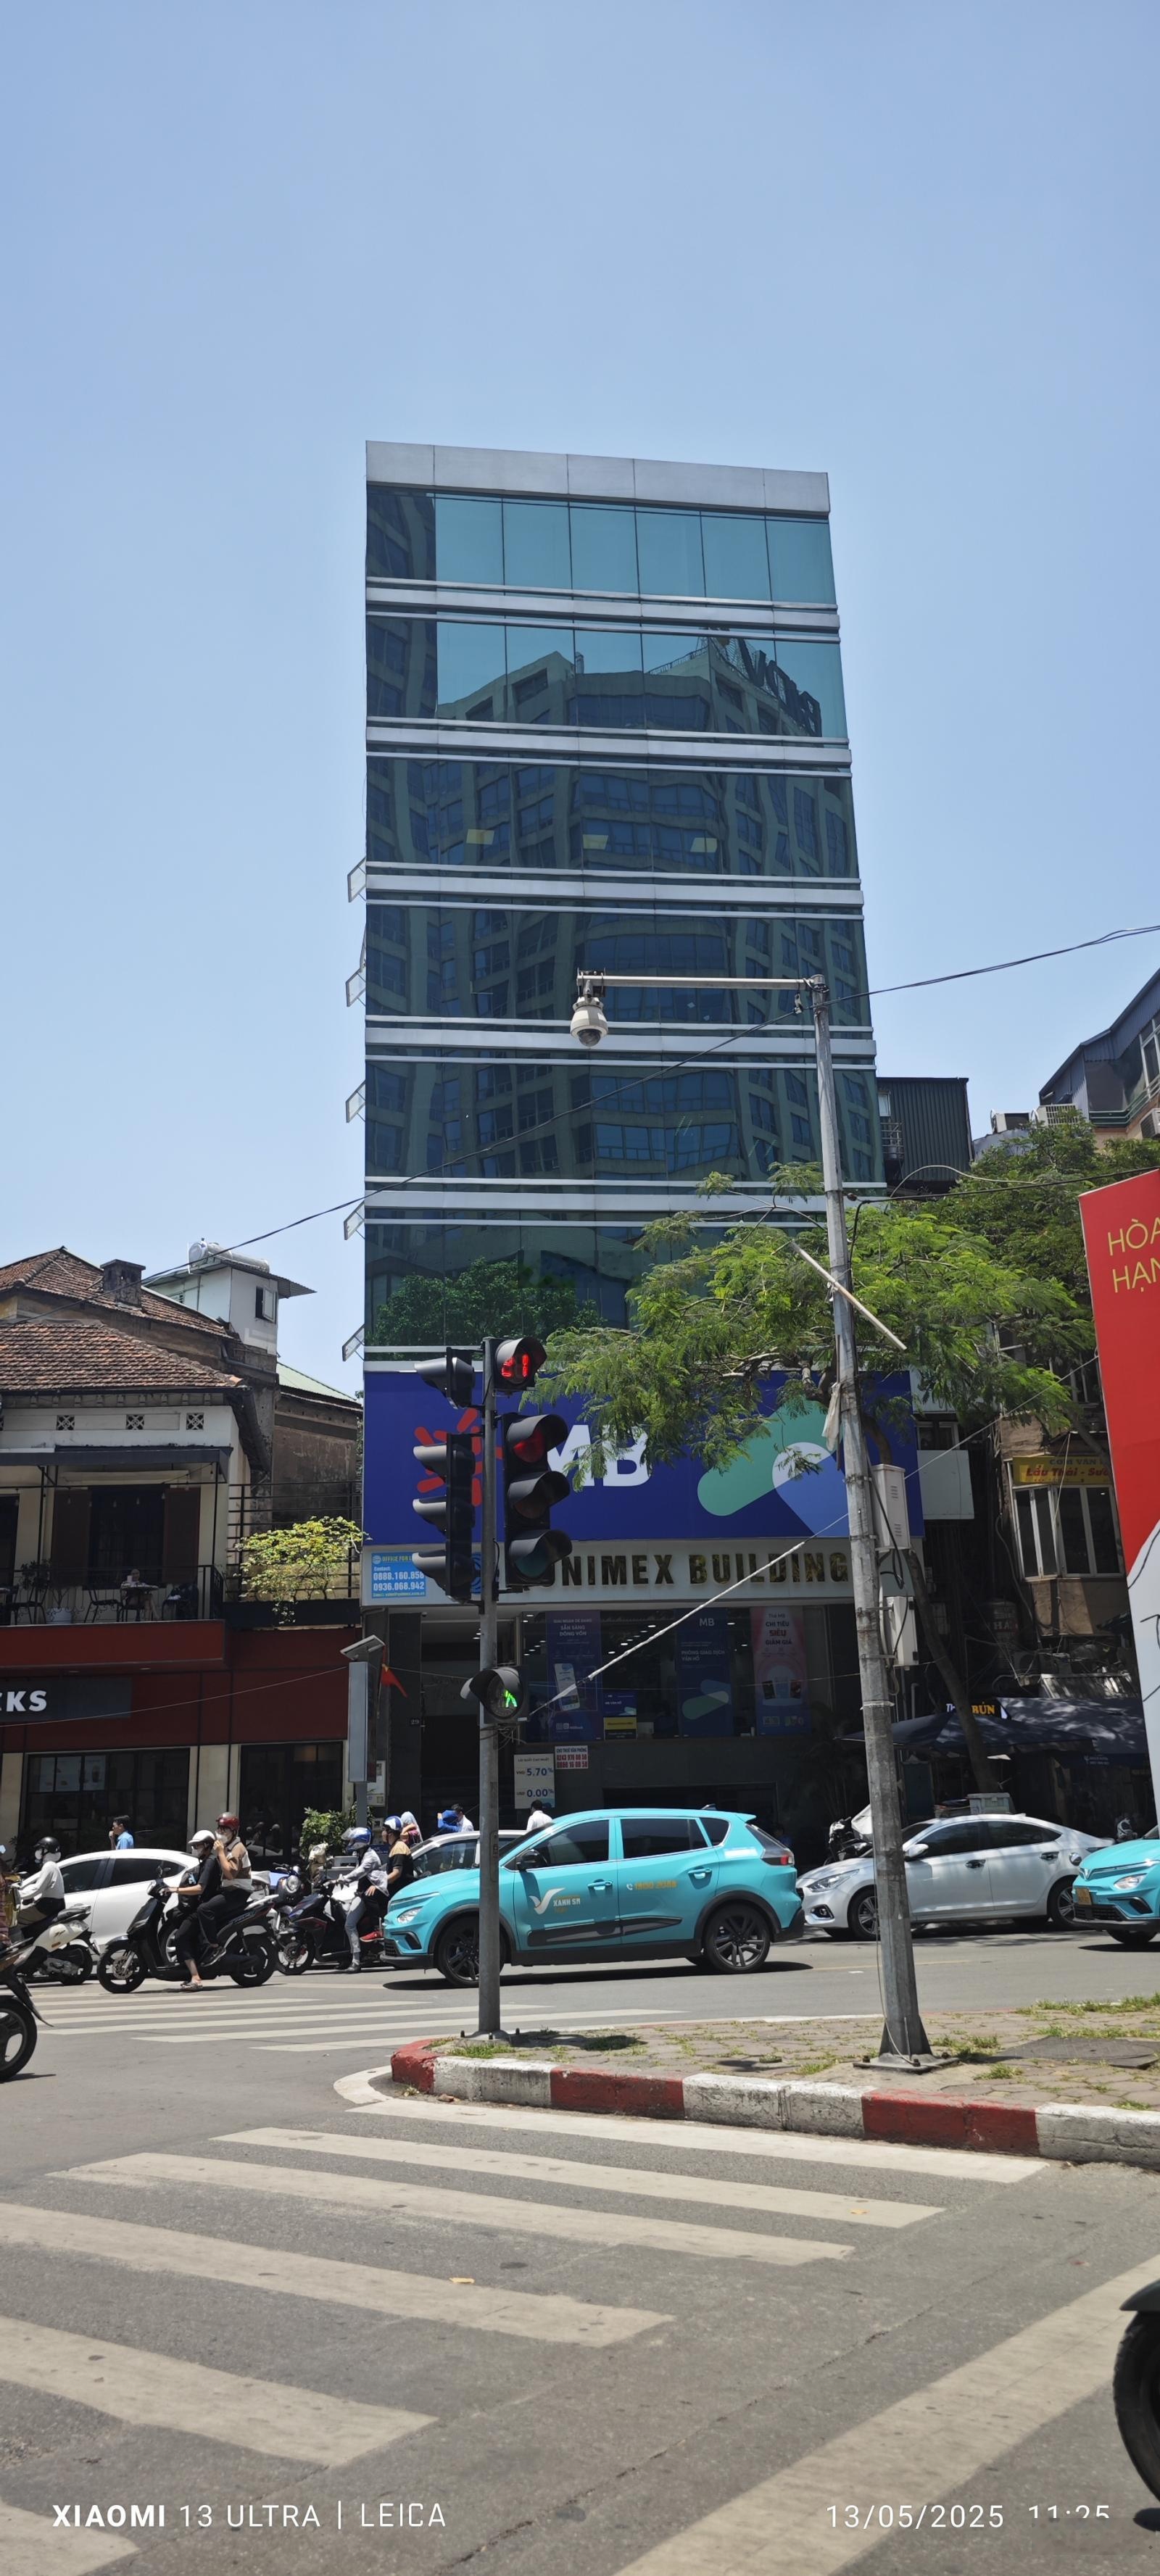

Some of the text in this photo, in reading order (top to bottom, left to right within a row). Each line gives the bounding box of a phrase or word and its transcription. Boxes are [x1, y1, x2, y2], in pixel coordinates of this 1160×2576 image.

[540, 1553, 847, 1587] NIMEX BUILDING
[699, 1618, 715, 1626] MB
[0, 1690, 47, 1711] KS
